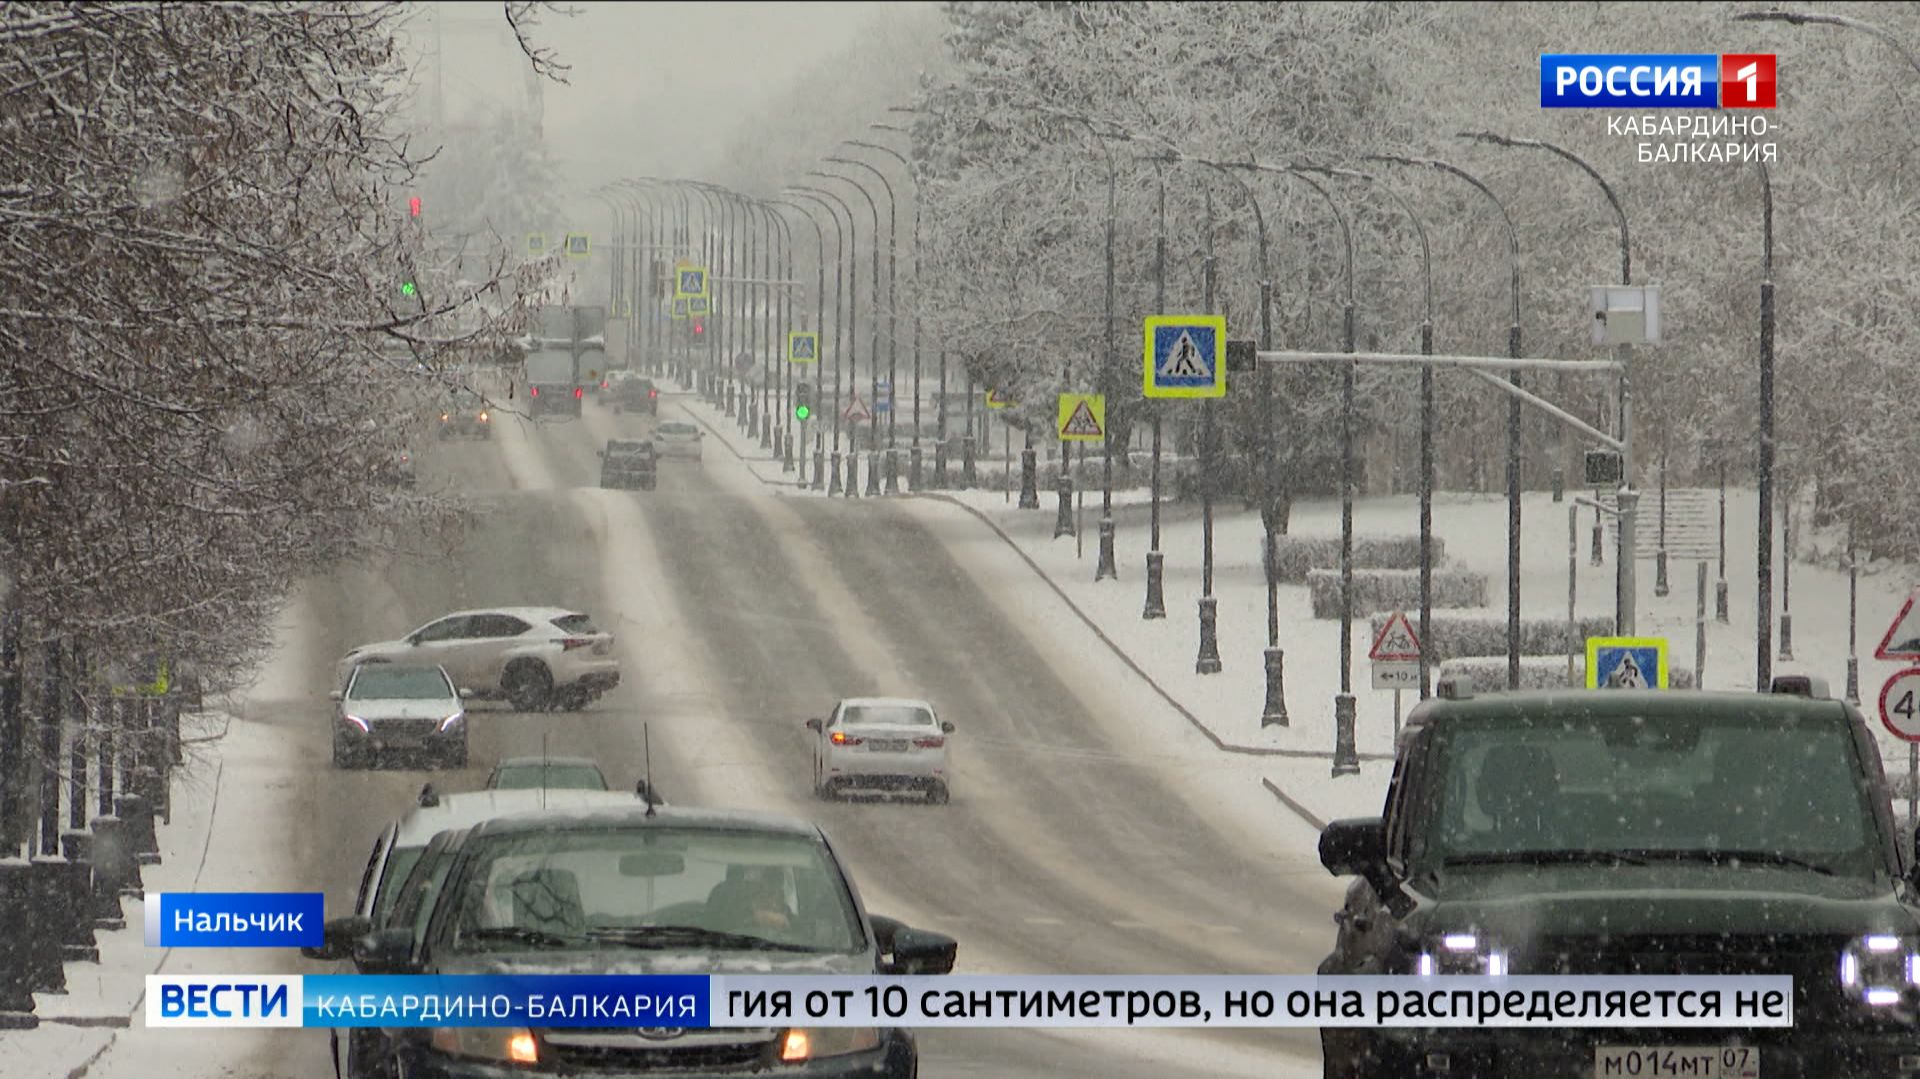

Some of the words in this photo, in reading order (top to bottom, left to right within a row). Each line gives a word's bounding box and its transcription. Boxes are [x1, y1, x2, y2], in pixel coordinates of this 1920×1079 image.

[1893, 690, 1920, 719] 4
[1605, 1050, 1714, 1076] М014МТ
[1723, 1049, 1749, 1068] 07
